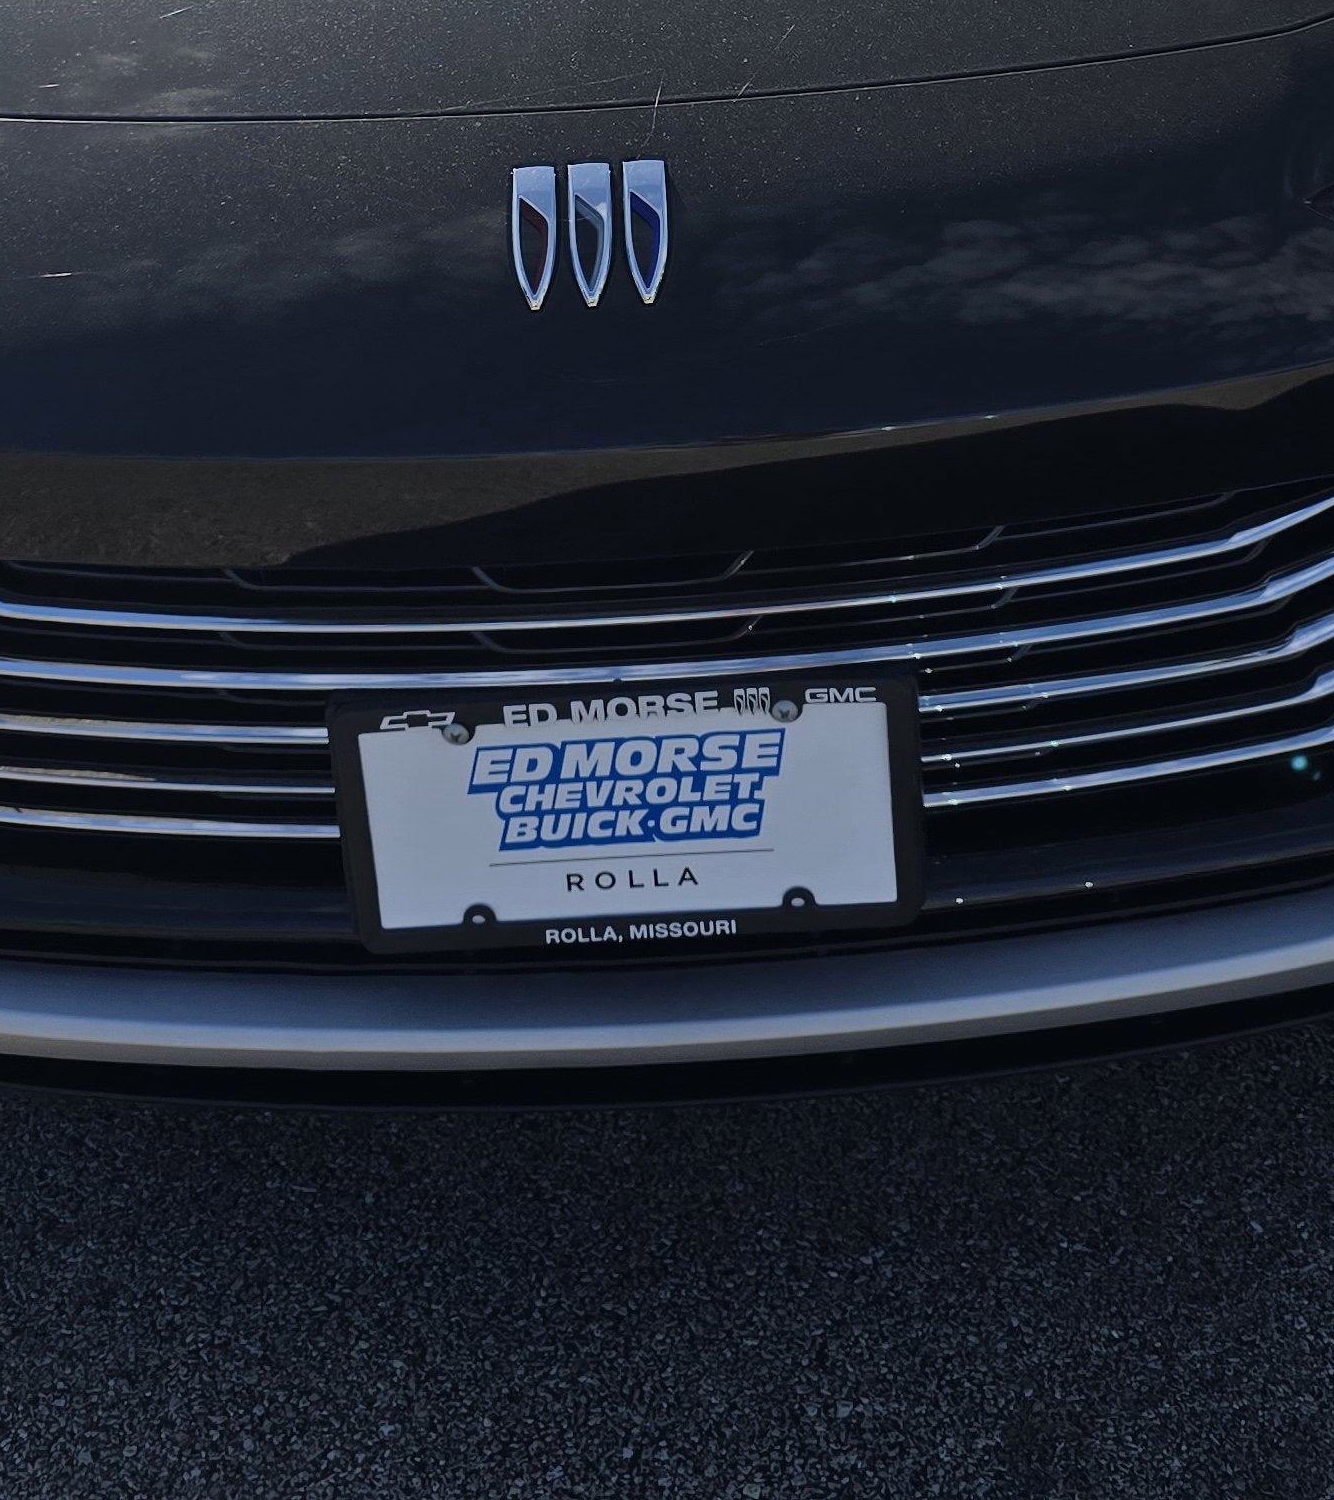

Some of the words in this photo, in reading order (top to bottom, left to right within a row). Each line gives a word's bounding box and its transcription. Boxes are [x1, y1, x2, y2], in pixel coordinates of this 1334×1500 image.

[502, 703, 557, 728] ED
[570, 690, 719, 724] MORSE
[804, 686, 877, 704] GMC
[472, 746, 554, 785] ED
[560, 731, 781, 780] MORSE
[566, 867, 699, 893] ROLLA
[545, 925, 624, 945] ROLLA,
[629, 919, 737, 941] MISSOURI
